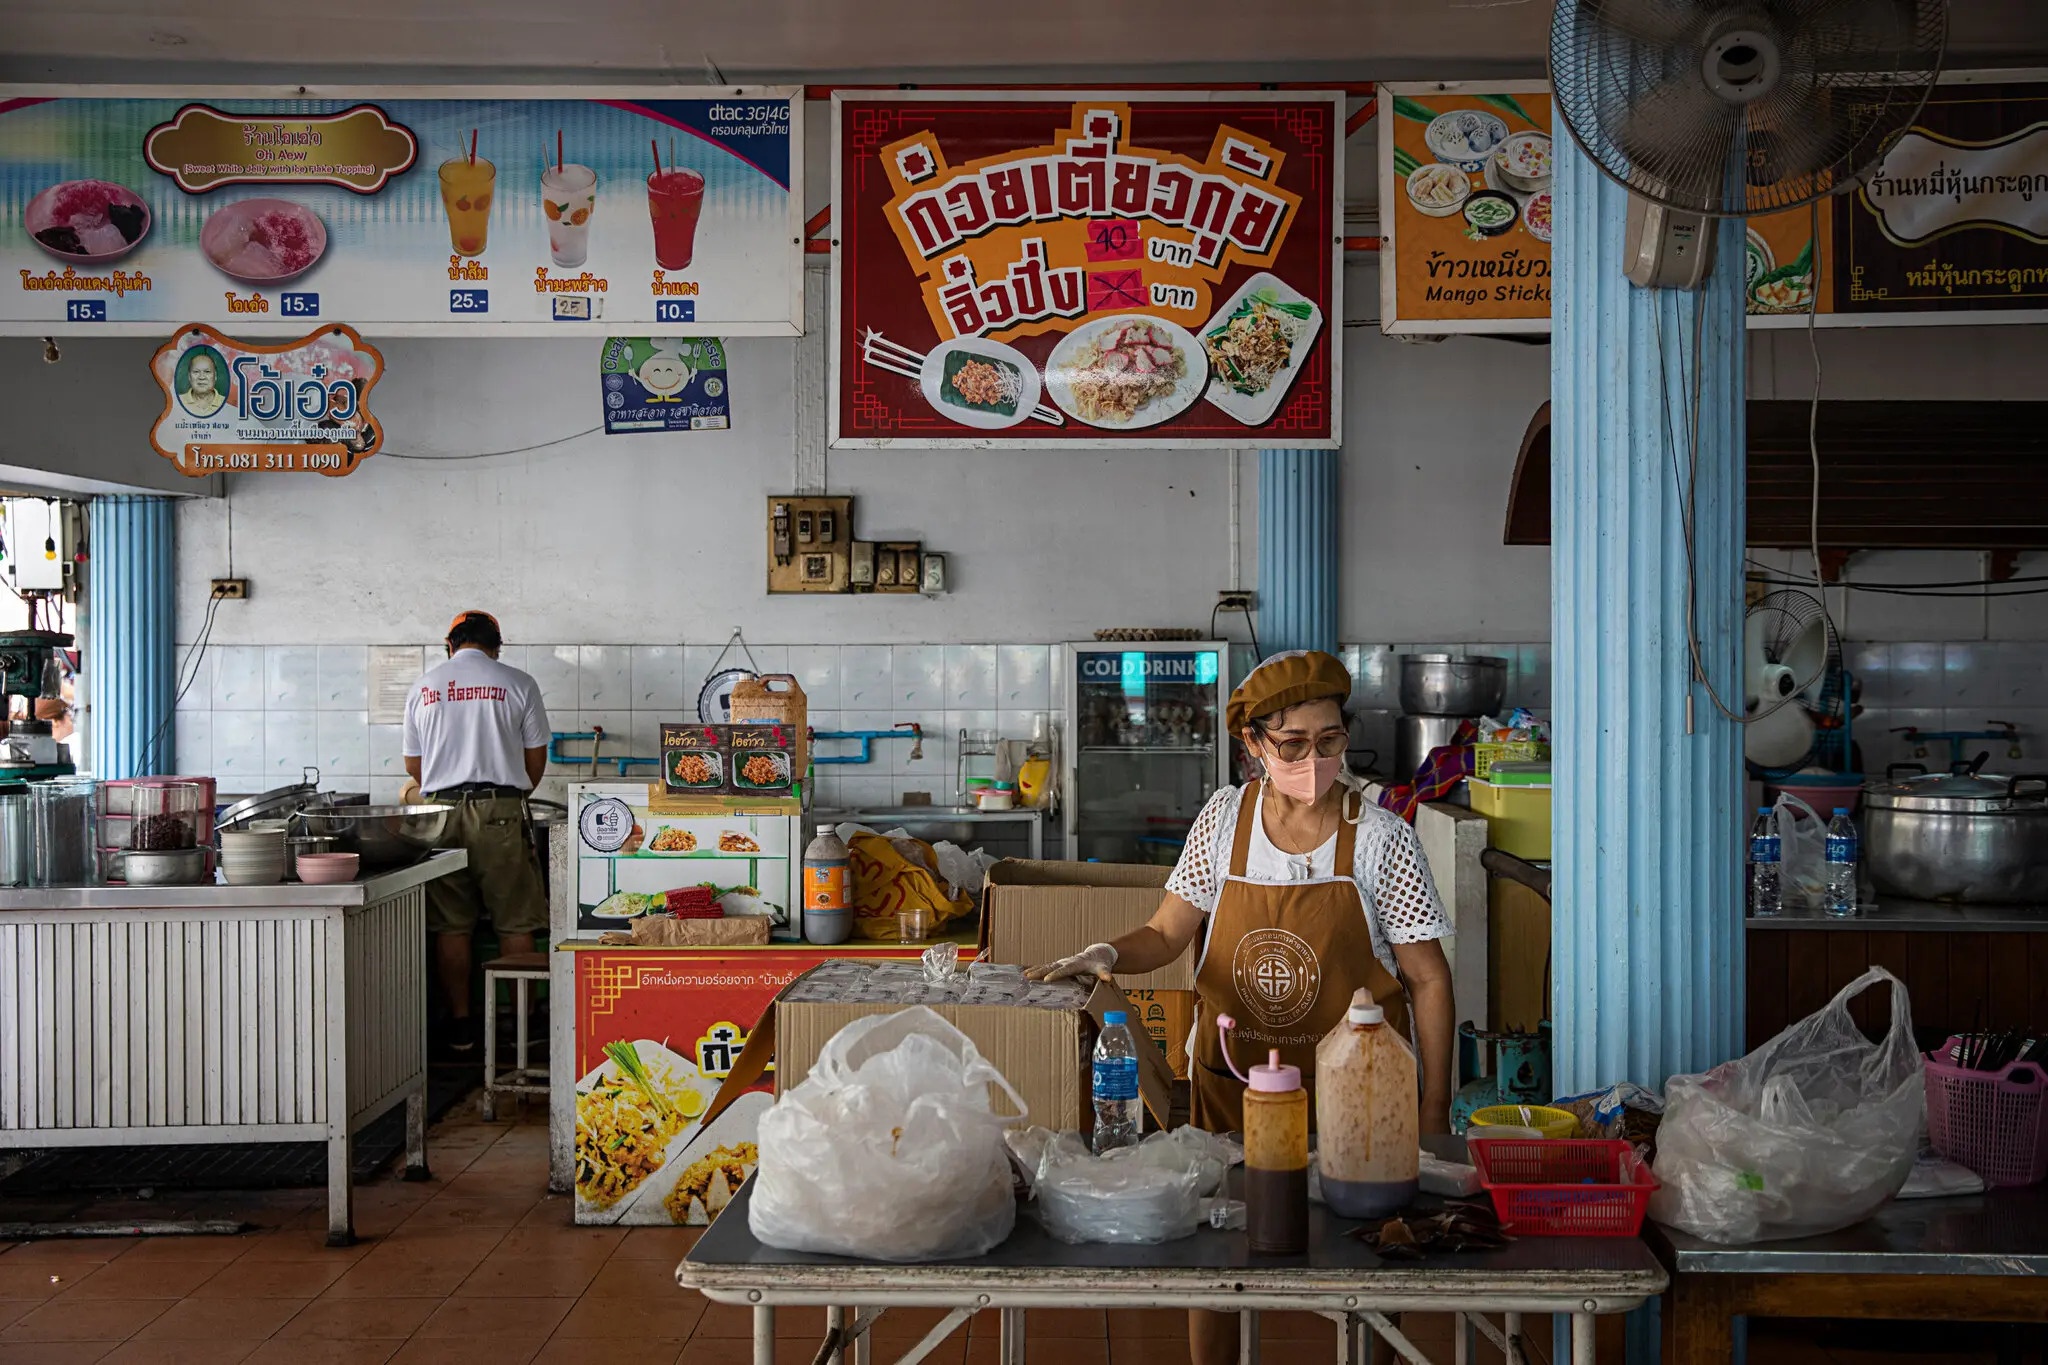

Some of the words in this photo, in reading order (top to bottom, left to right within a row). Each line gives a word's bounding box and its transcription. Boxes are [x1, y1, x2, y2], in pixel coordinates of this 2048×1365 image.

[709, 103, 743, 122] dtac
[711, 122, 788, 138] ครอบคลุมทั่วไทย
[256, 149, 275, 161] Oh
[278, 149, 306, 161] Aew
[183, 164, 215, 175] (Sweet
[216, 164, 244, 175] White
[246, 164, 267, 176] Jelly
[270, 164, 289, 174] with
[292, 164, 306, 175] Ice
[309, 164, 333, 175] Flake
[336, 164, 376, 176] Topping)
[1094, 225, 1127, 251] 40
[1151, 238, 1193, 268] บาท
[448, 256, 488, 281] น้ำส้ม
[1426, 251, 1551, 279] ข้าวเหนียว
[534, 267, 608, 293] น้ำมะพร้าว
[651, 270, 698, 295] น้ำแดง
[225, 292, 269, 313] โอเอ๋ว
[283, 297, 317, 312] 15.-
[452, 293, 486, 308] 25.-
[1152, 284, 1195, 309] บาท
[1426, 286, 1487, 306] Mango
[70, 304, 104, 319] 15.-
[560, 300, 580, 314] 25
[659, 304, 692, 319] 10.-
[232, 356, 356, 419] โอ้เอ๋ว
[608, 408, 666, 421] อาหารสะอาด
[192, 447, 258, 469] โทร.081
[265, 453, 295, 469] 311
[302, 453, 341, 469] 1090
[1083, 660, 1134, 676] COLD
[642, 972, 754, 986] อีกหนึ่งความอร่อยจาก
